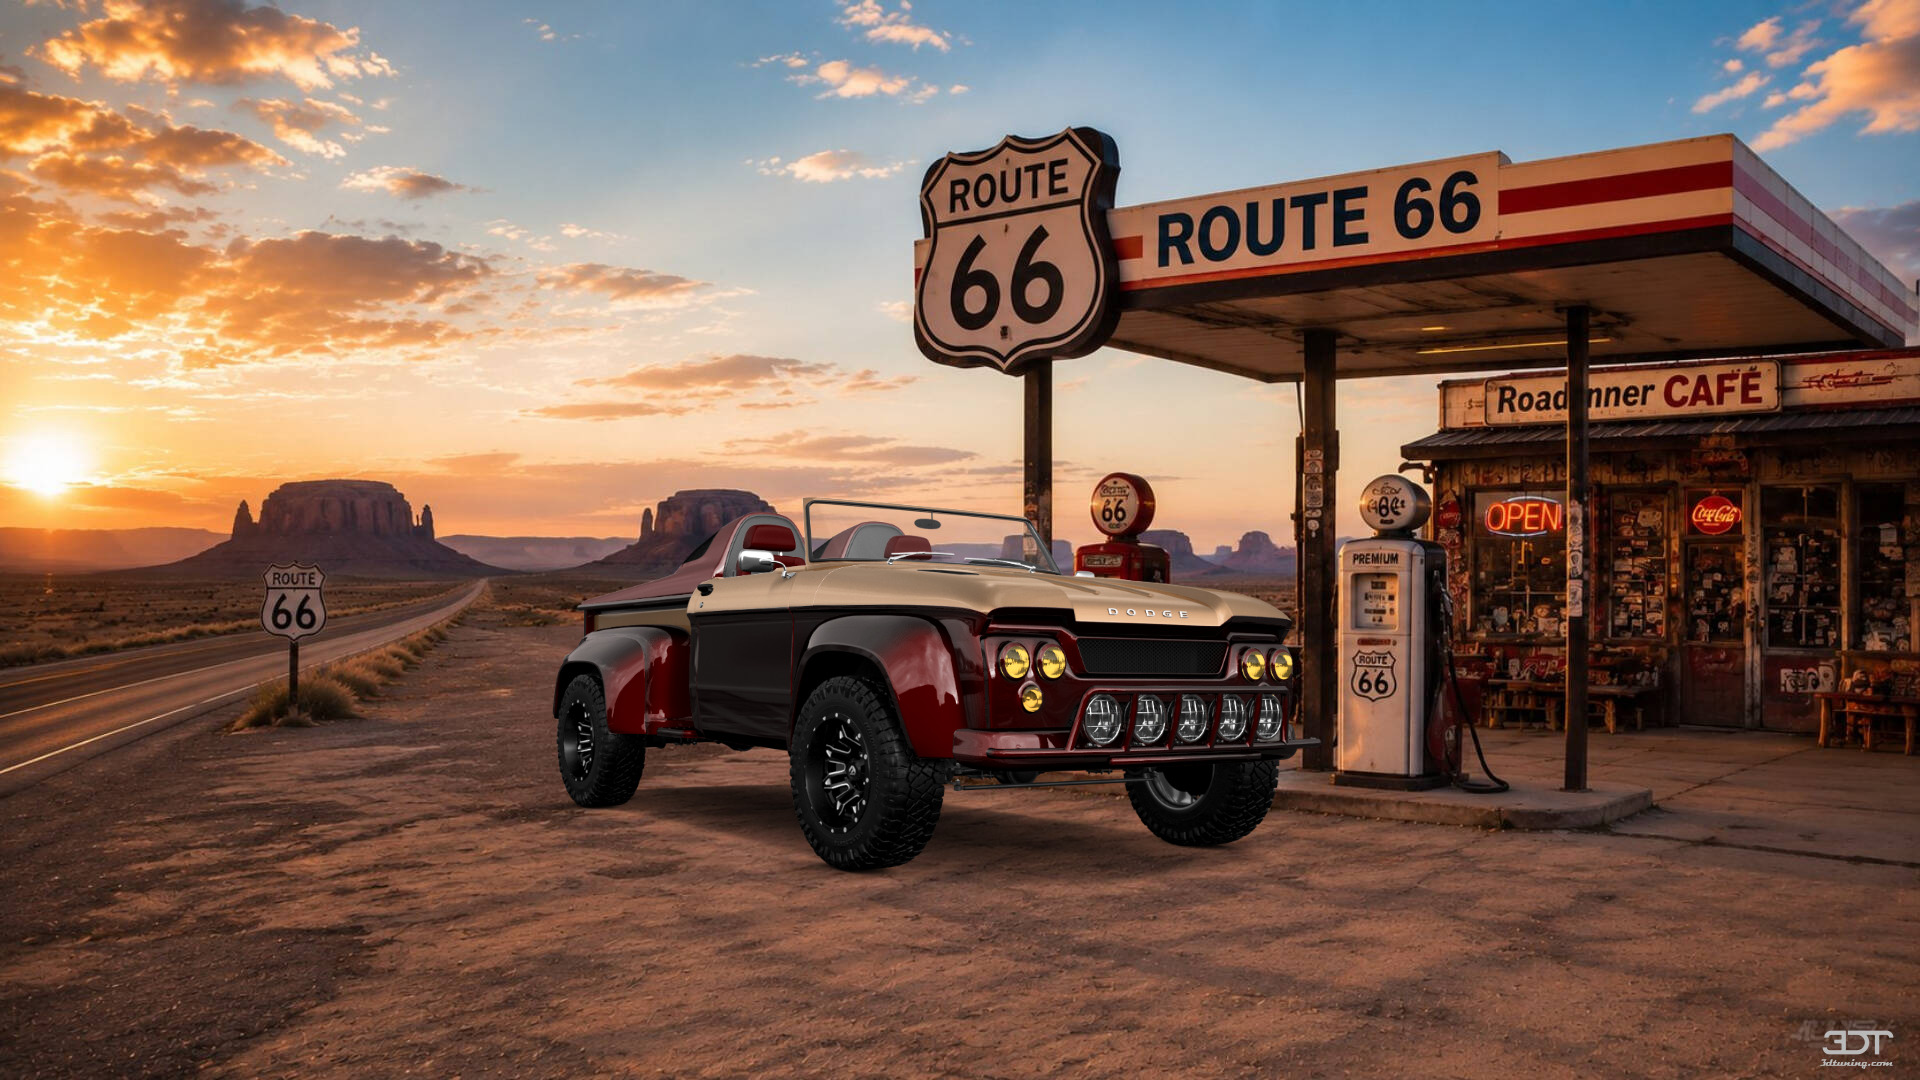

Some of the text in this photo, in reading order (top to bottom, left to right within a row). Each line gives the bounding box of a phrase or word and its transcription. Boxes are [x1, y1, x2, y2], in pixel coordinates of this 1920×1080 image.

[949, 158, 1069, 213] ROUTE
[1157, 170, 1482, 268] ROUTE 66
[950, 224, 1064, 331] 66
[1497, 382, 1655, 414] Roadnner
[1101, 499, 1127, 522] 66
[1487, 502, 1559, 531] OPEN
[1352, 552, 1399, 565] PREMIUM
[272, 572, 316, 586] ROUTE
[272, 593, 316, 630] 66
[1107, 607, 1189, 619] DODGE
[1358, 655, 1388, 665] ROUTE
[1358, 670, 1389, 694] 66
